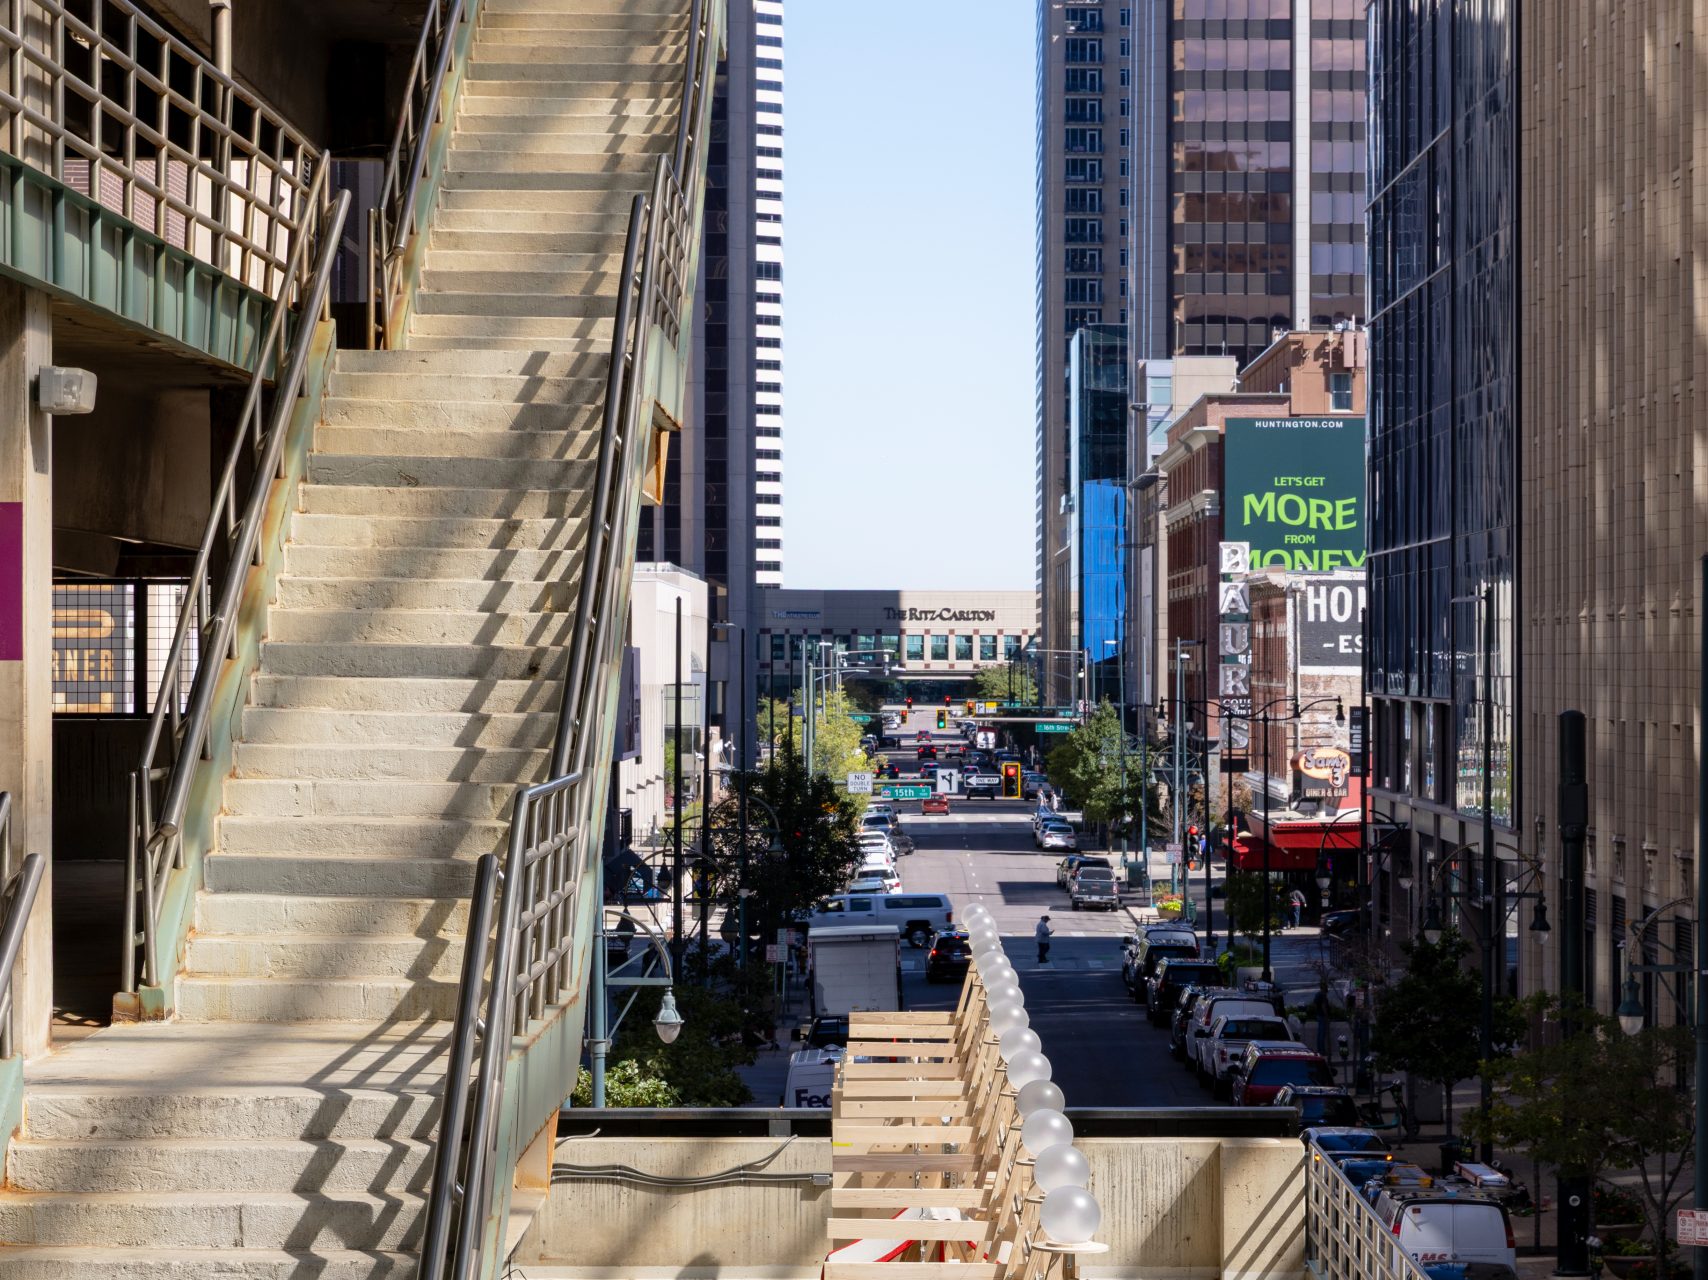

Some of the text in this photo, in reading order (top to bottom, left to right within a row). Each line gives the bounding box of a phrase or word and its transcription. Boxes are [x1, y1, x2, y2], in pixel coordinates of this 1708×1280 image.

[1274, 477, 1325, 486] LET'S GET
[1243, 492, 1357, 530] MORE
[1284, 535, 1315, 544] FROM
[884, 608, 906, 620] THE
[1304, 750, 1348, 769] Sam's
[1332, 768, 1343, 786] 3
[894, 787, 914, 797] 15th
[1305, 788, 1326, 797] DINER
[1334, 788, 1347, 797] BAR
